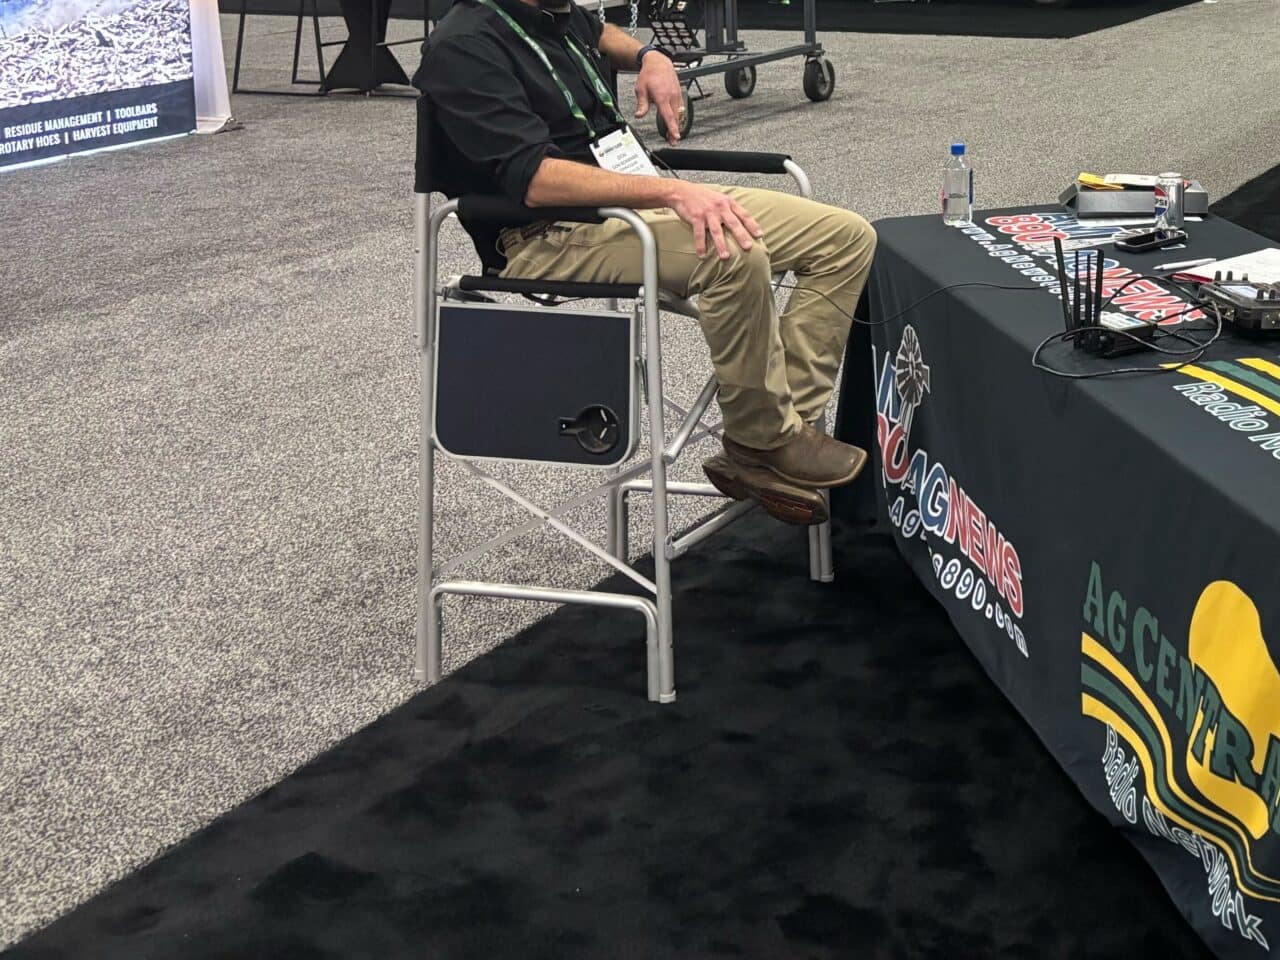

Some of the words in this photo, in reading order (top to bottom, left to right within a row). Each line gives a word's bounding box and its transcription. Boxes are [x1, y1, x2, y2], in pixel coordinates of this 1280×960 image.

[4, 121, 43, 139] RESIDUE
[45, 111, 103, 132] MANAGEMENT
[114, 103, 158, 119] TOOLBARS
[36, 134, 61, 148] HOES
[72, 126, 111, 142] HARVEST
[113, 117, 159, 135] EQUIPMENT
[1173, 381, 1269, 432] Radio
[902, 449, 1024, 618] AGNEWS
[1083, 560, 1127, 654] AG
[1101, 720, 1139, 825] Radio
[1143, 795, 1270, 951] Network
